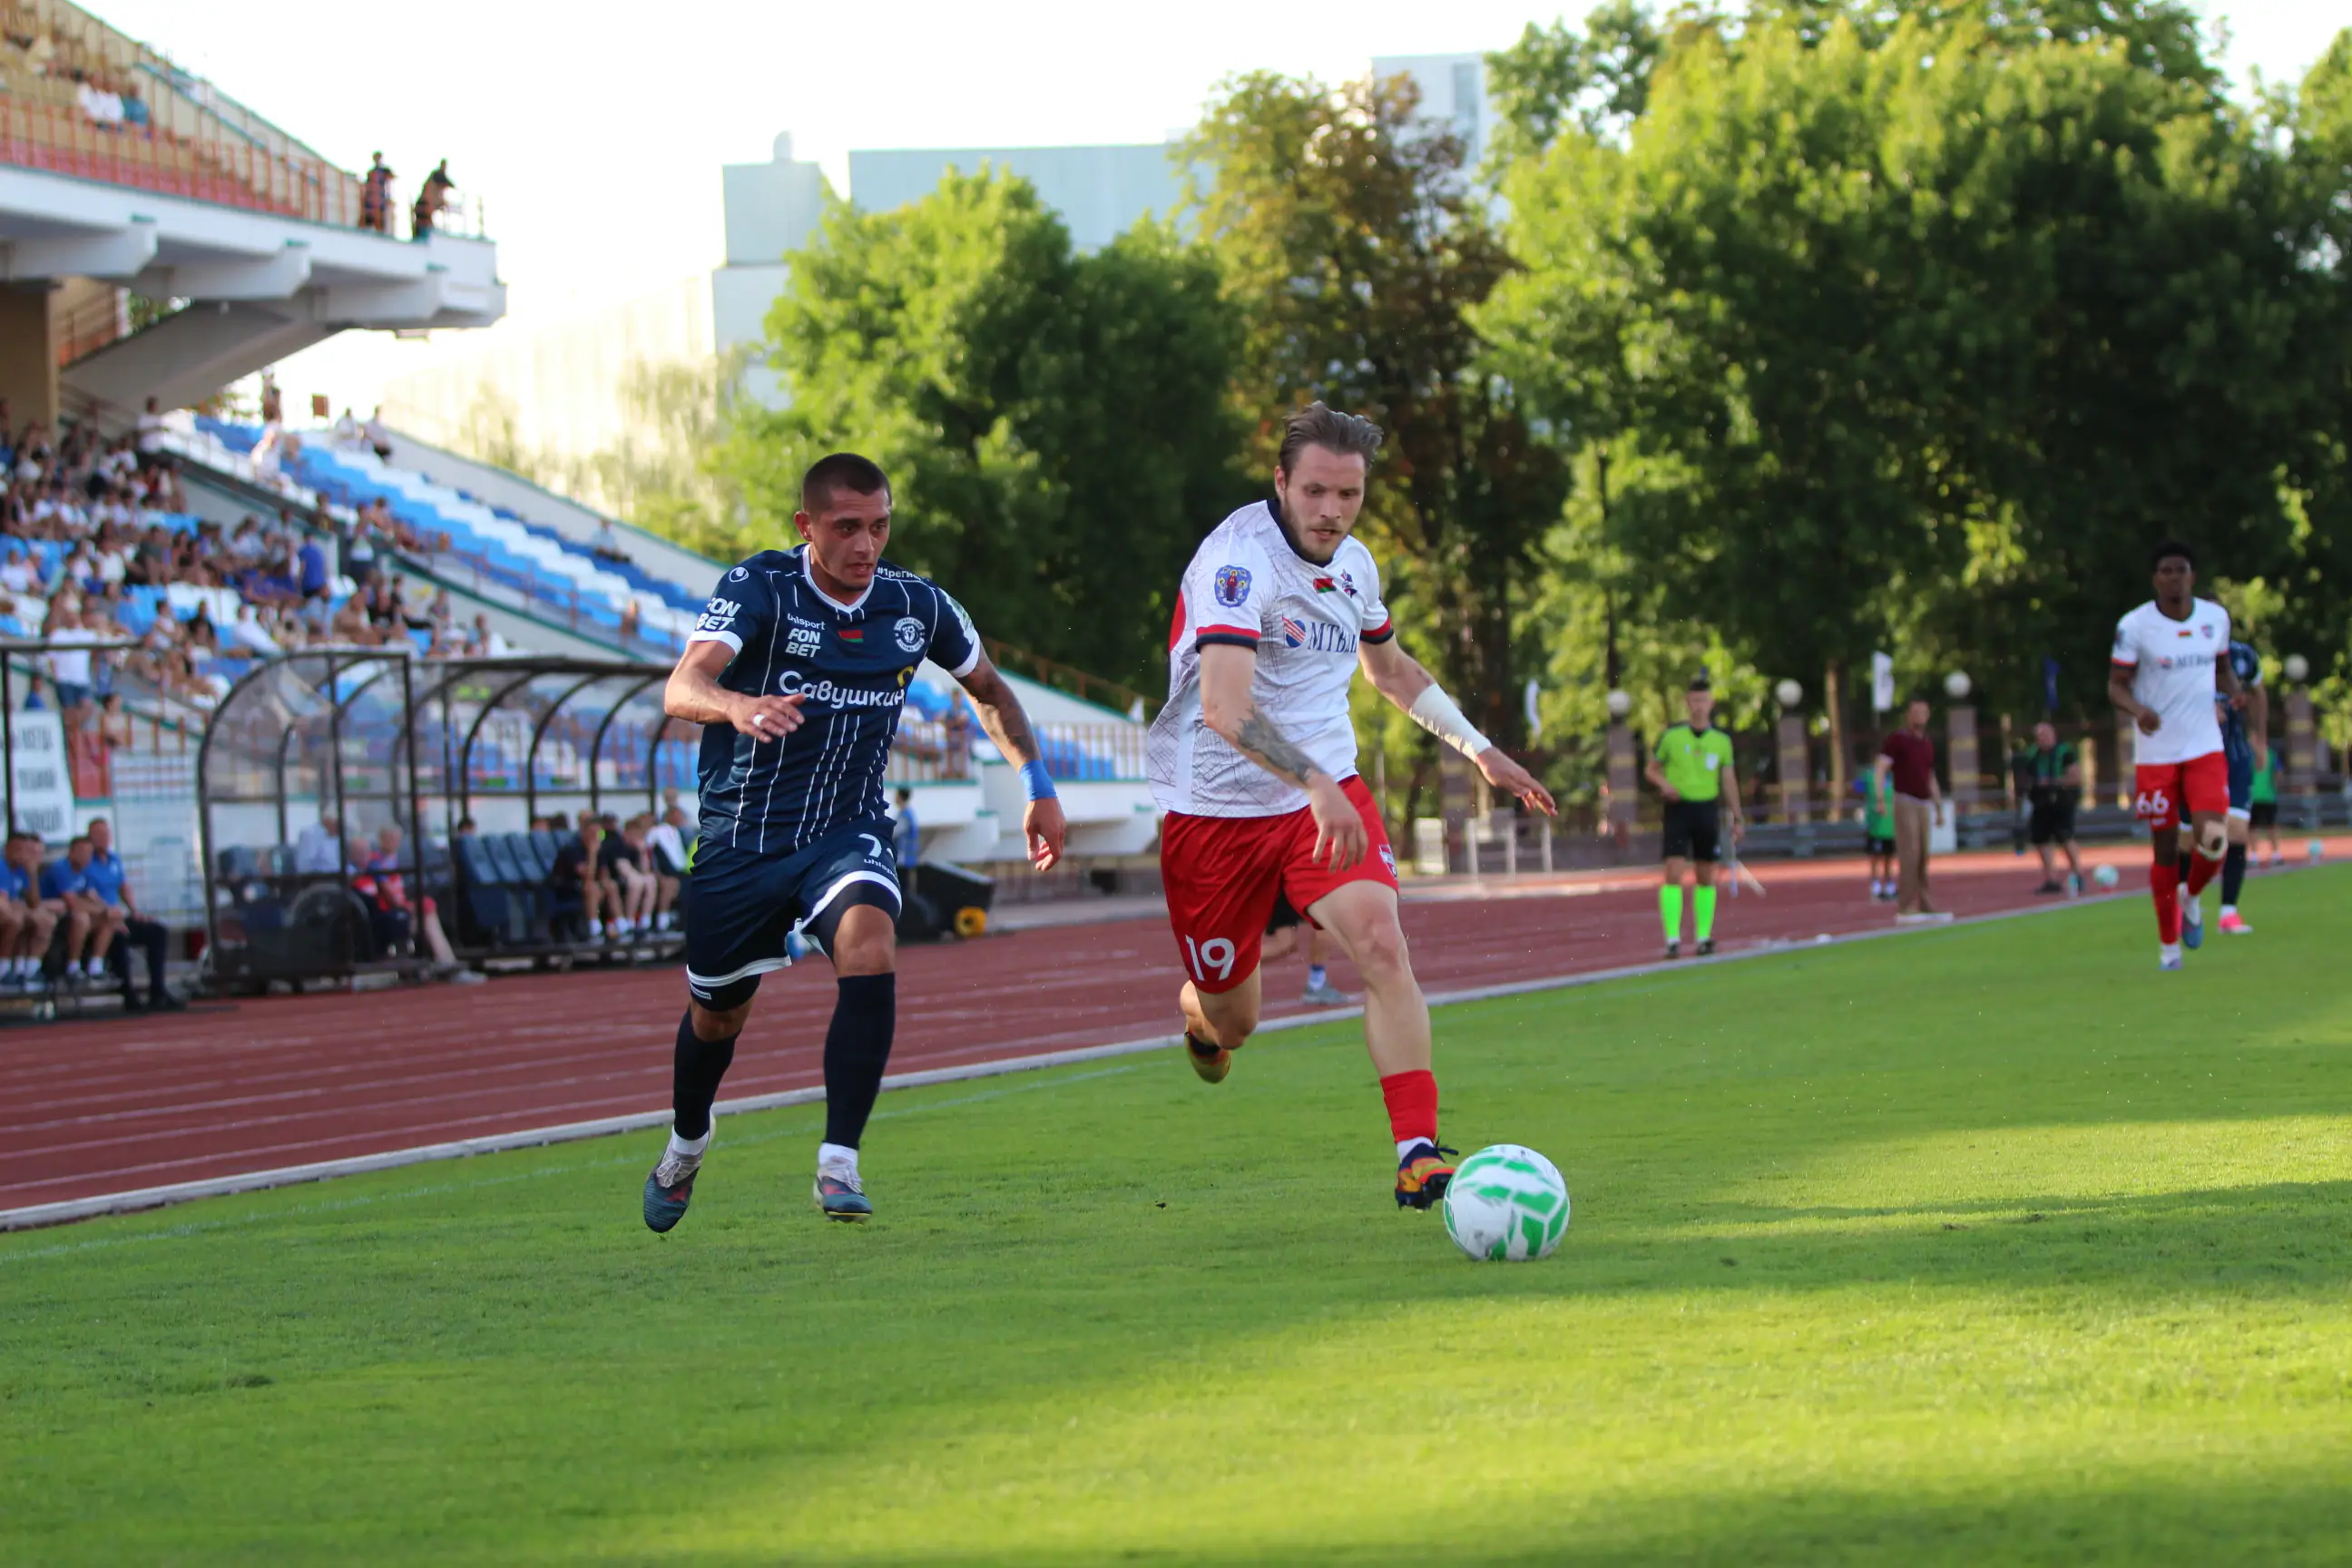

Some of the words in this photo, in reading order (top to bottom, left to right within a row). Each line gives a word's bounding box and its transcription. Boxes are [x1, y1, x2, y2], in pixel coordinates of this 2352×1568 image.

[695, 612, 736, 631] BET
[787, 612, 826, 631] uhlsport
[788, 627, 821, 643] FON
[785, 641, 821, 658] BET
[779, 670, 906, 710] Савушкин
[2136, 789, 2170, 815] 66
[1185, 933, 1236, 982] 19
